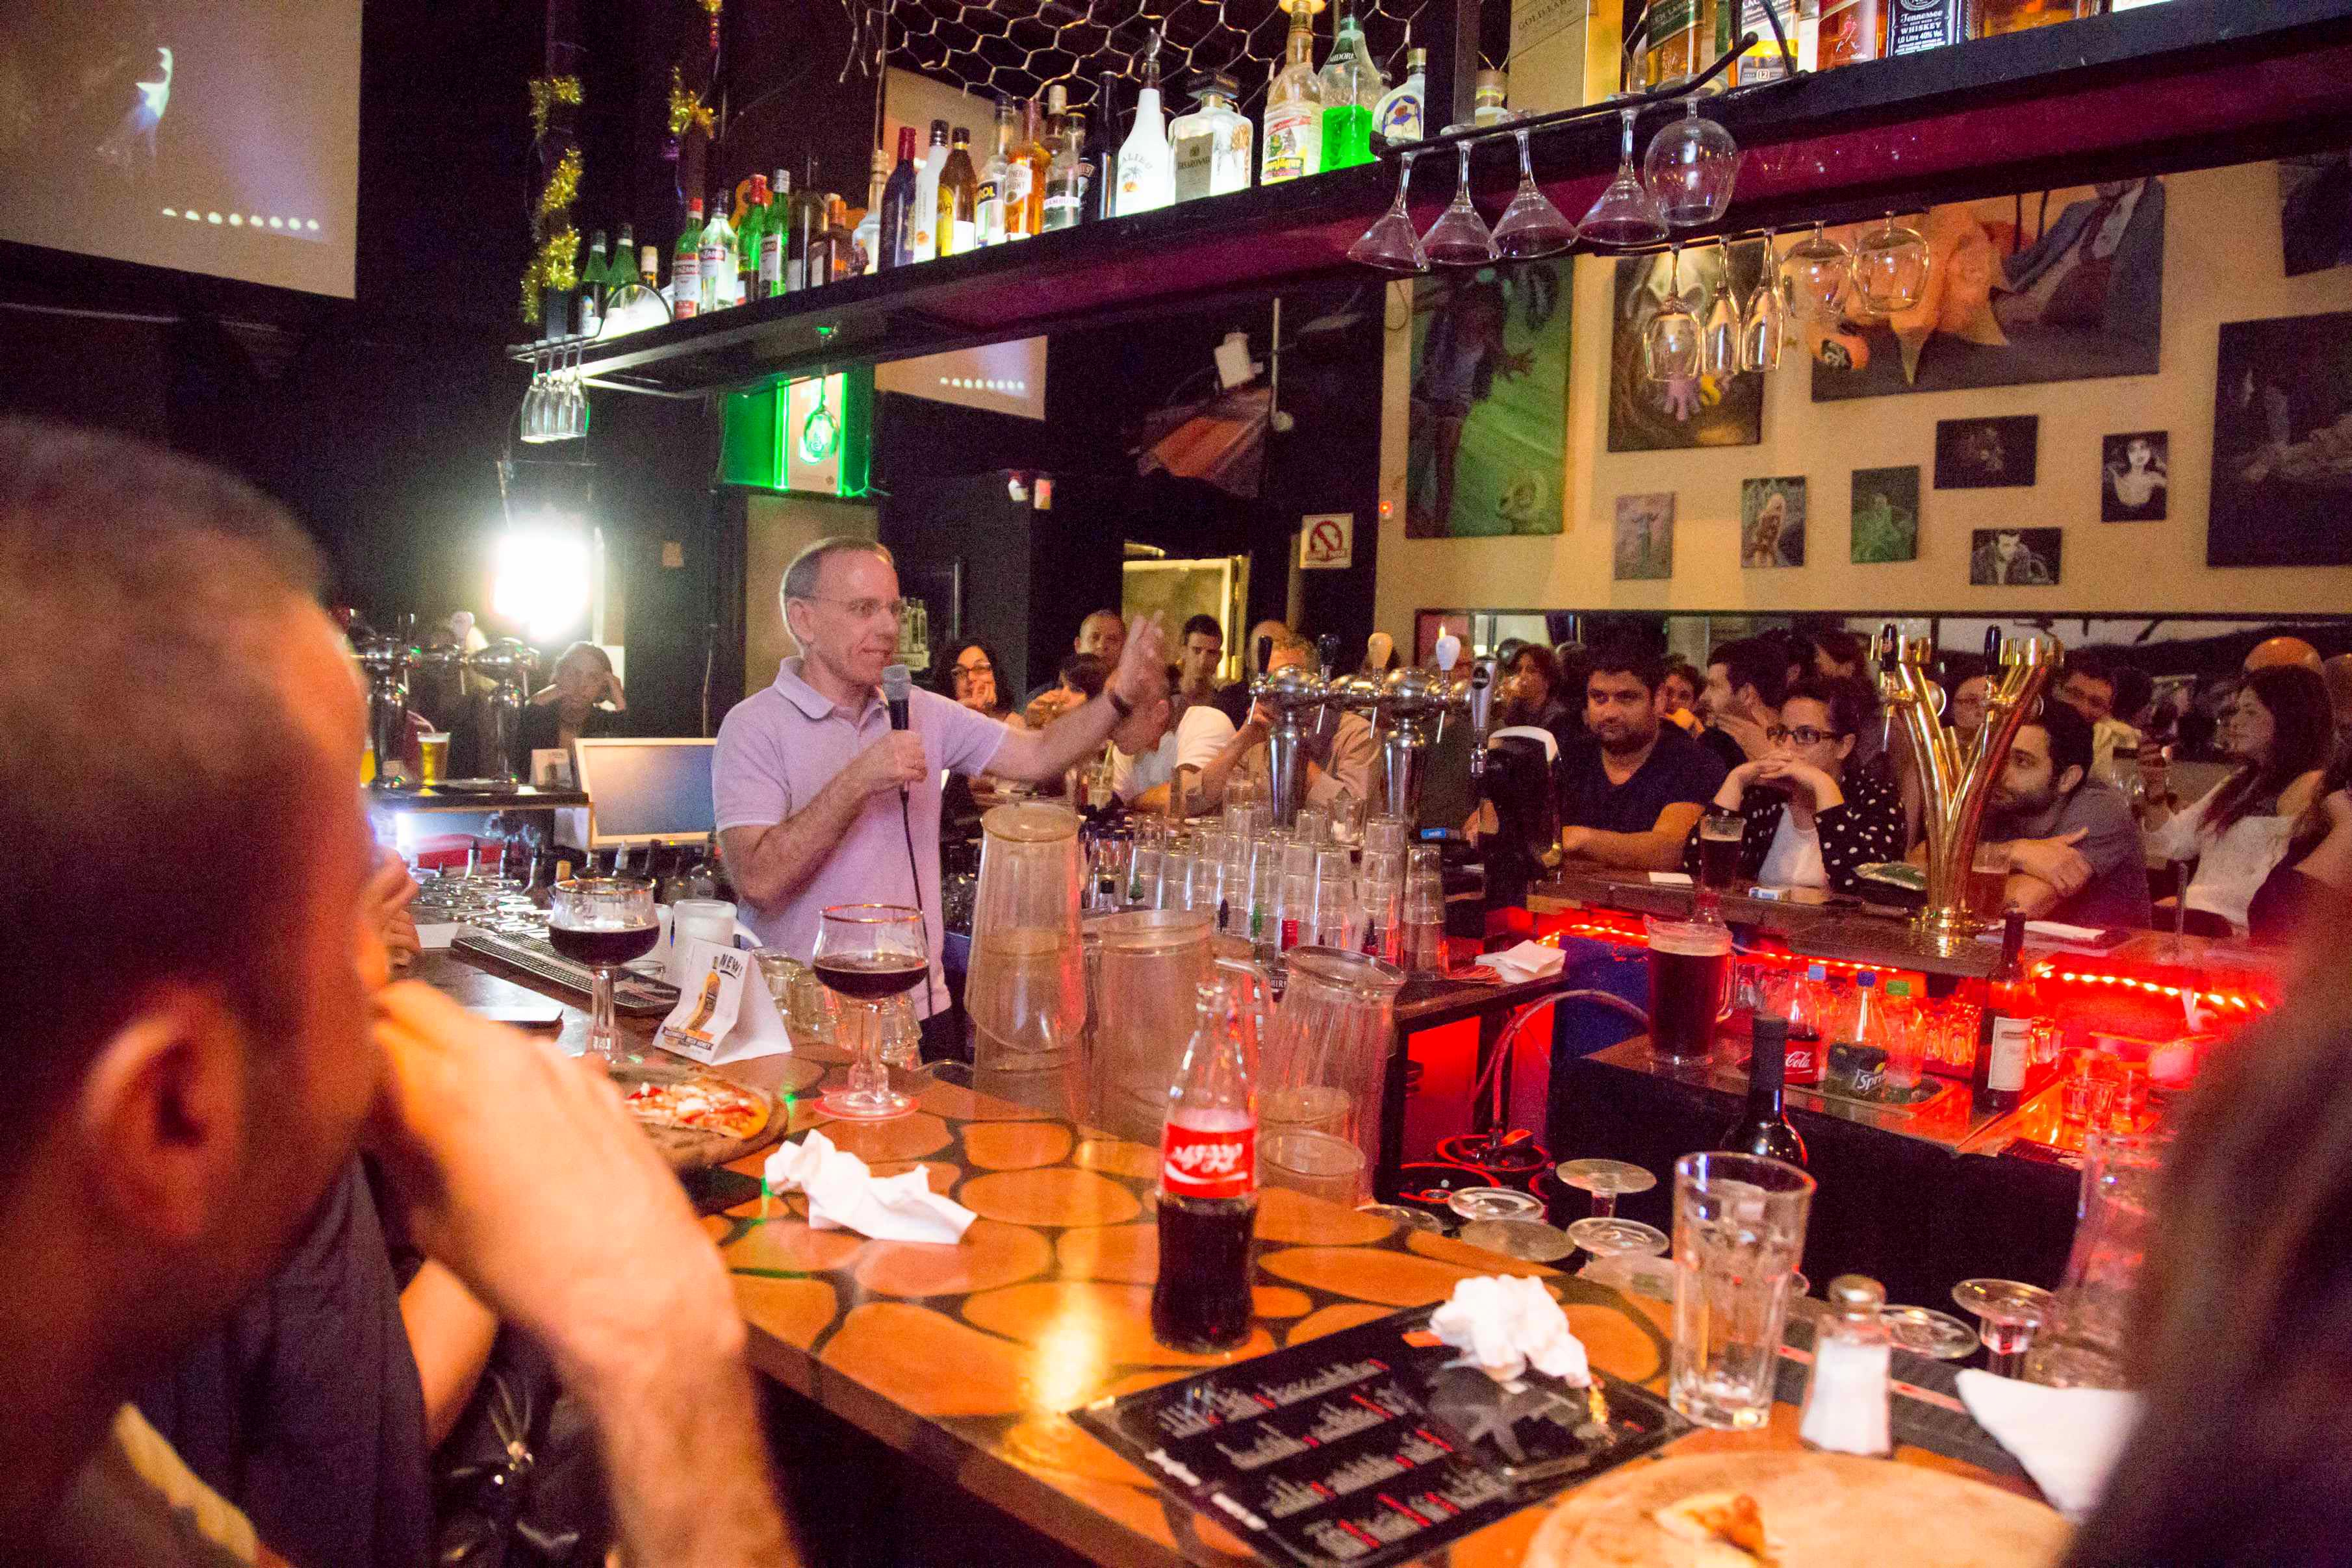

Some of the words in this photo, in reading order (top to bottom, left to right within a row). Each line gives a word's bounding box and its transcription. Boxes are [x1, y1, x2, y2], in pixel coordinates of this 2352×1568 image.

[1518, 9, 1545, 30] GOLD
[1900, 10, 1943, 23] Tennessee
[1900, 21, 1941, 34] WHISKEY
[1758, 70, 1769, 79] 12
[719, 953, 743, 978] NEW!
